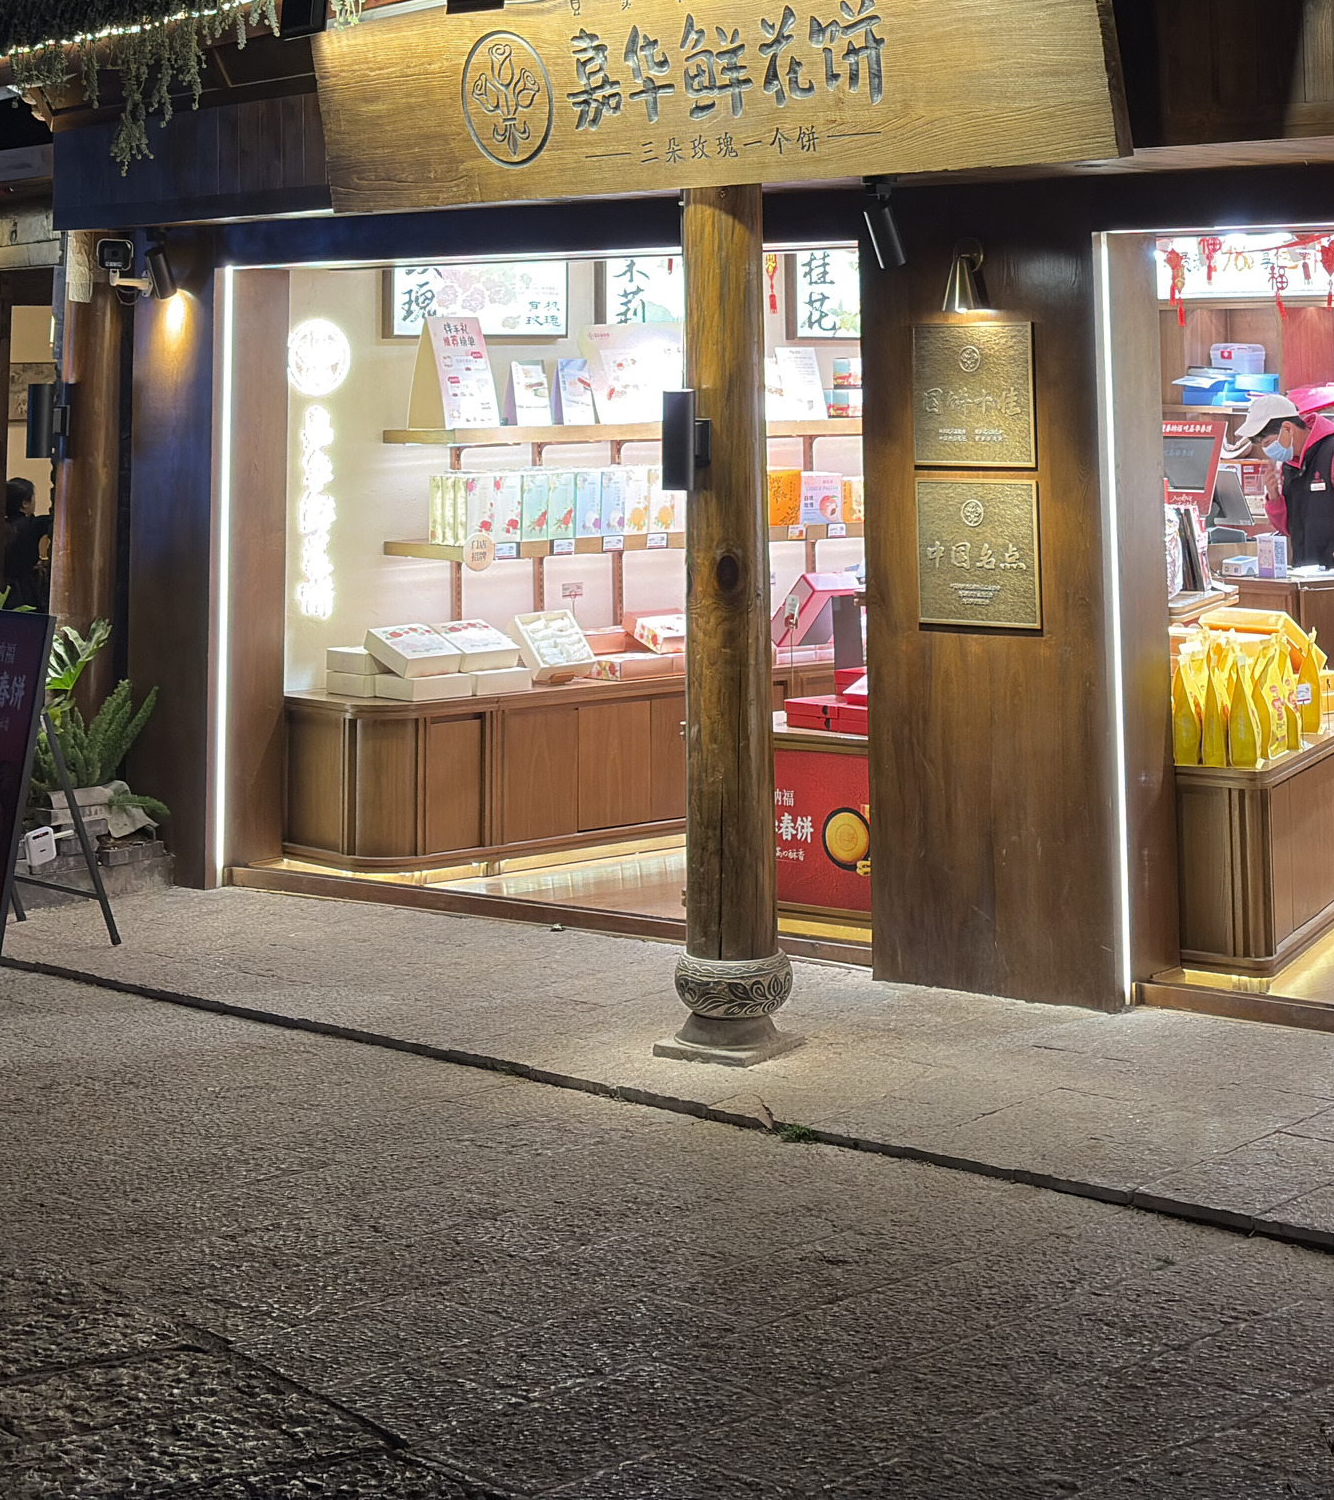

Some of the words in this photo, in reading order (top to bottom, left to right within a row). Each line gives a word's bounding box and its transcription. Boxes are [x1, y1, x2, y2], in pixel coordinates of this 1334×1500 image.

[640, 125, 820, 164] 三朵玫瑰一个饼
[802, 251, 836, 332] 桂花
[526, 315, 562, 328] 玫瑰
[926, 540, 1027, 571] 中国名点
[775, 812, 814, 844] 春饼
